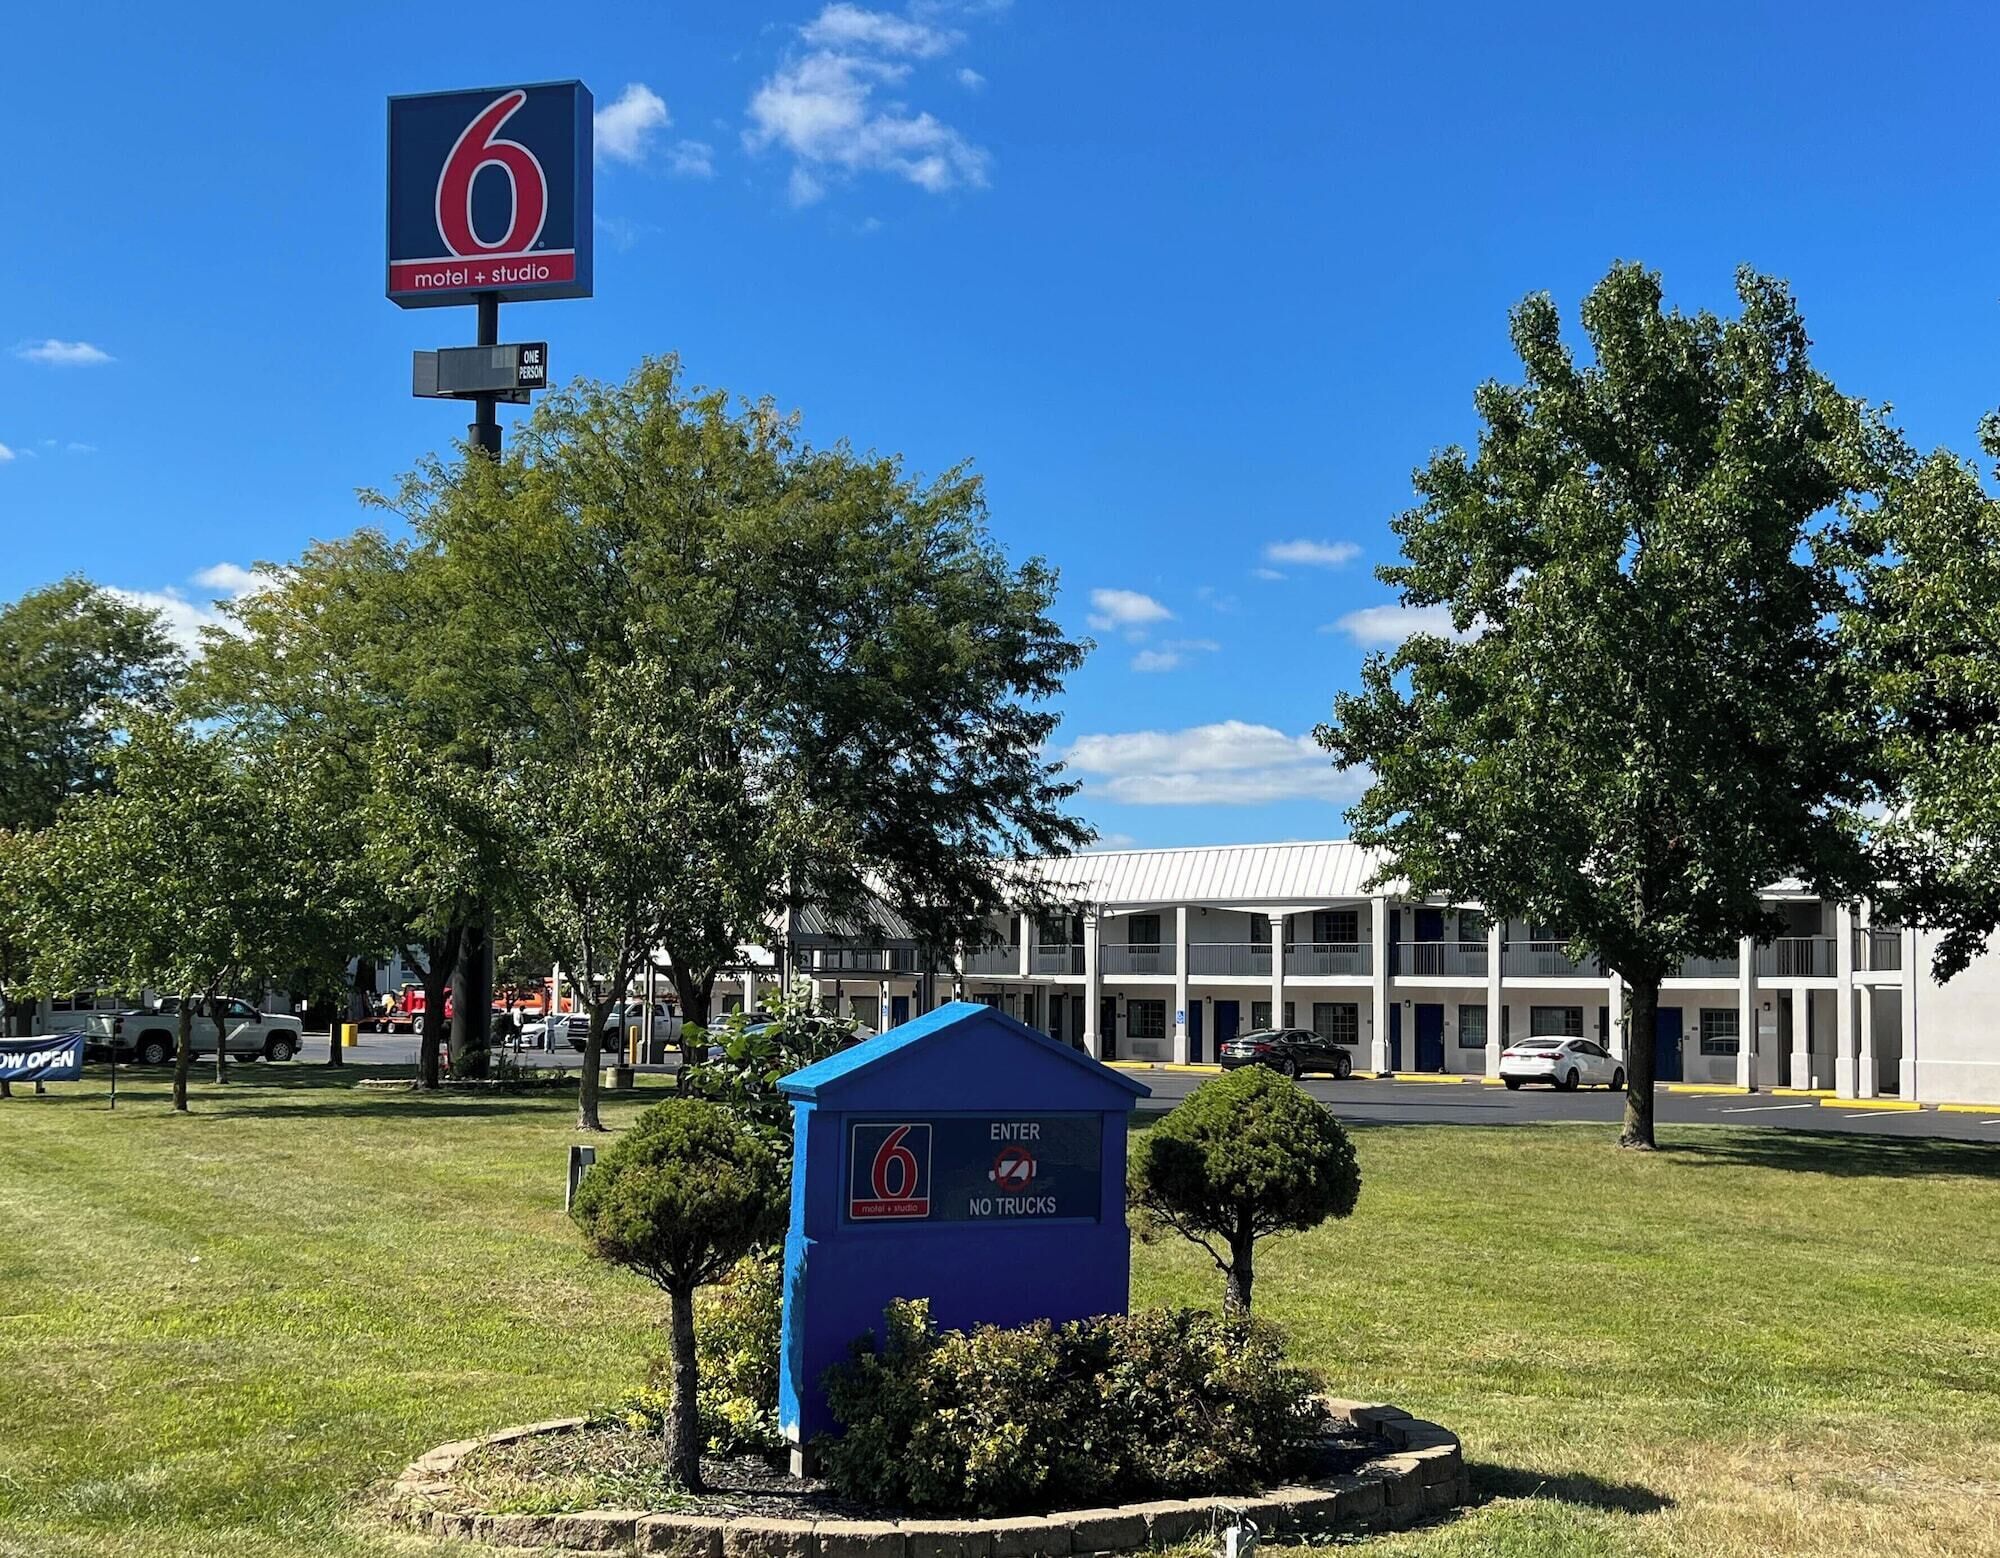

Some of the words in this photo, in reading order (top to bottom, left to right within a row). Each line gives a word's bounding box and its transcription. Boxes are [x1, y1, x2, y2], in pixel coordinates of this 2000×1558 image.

[435, 89, 548, 257] 6
[415, 268, 468, 287] motel
[491, 264, 550, 283] studio
[523, 350, 539, 364] ONE
[519, 365, 544, 379] PERSON
[27, 1050, 75, 1068] OPEN
[990, 1123, 1040, 1140] ENTER
[871, 1124, 918, 1200] 6
[862, 1204, 885, 1213] motel
[894, 1203, 918, 1212] studio
[969, 1198, 992, 1216] NO
[995, 1196, 1057, 1215] TRUCKS
